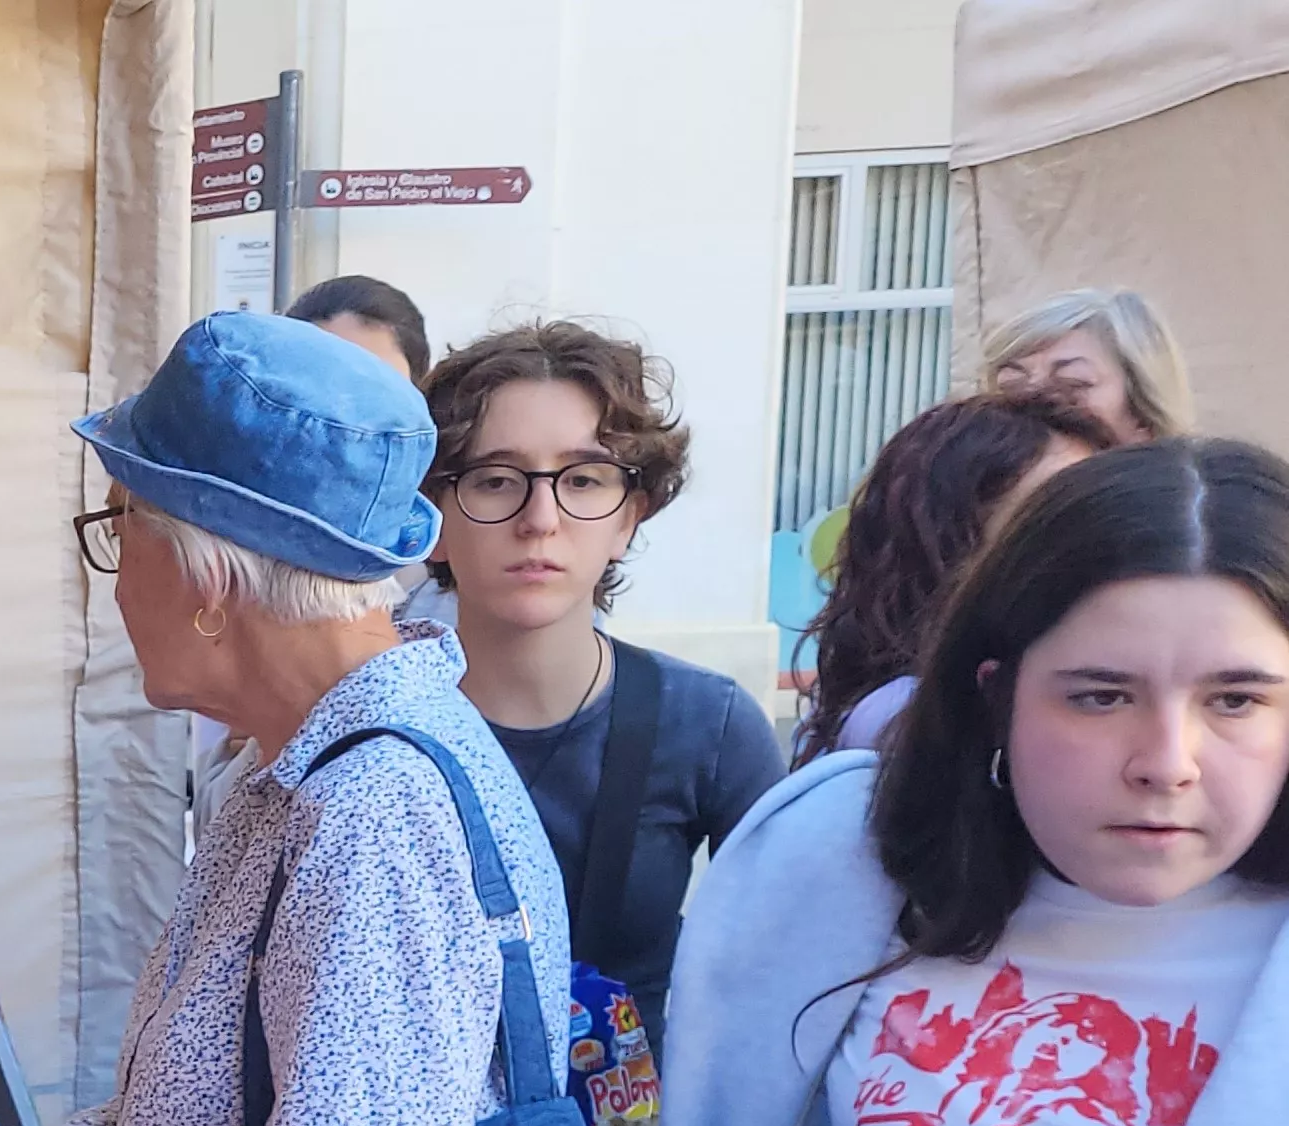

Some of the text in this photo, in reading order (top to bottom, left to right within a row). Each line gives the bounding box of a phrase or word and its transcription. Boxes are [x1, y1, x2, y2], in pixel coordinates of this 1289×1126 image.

[202, 171, 244, 188] Catedral
[346, 174, 452, 188] Iglesia y Claustro
[345, 188, 363, 200] de
[364, 187, 390, 200] San
[391, 186, 428, 200] Pedro
[445, 186, 475, 201] Viejo
[854, 1065, 906, 1110] the
